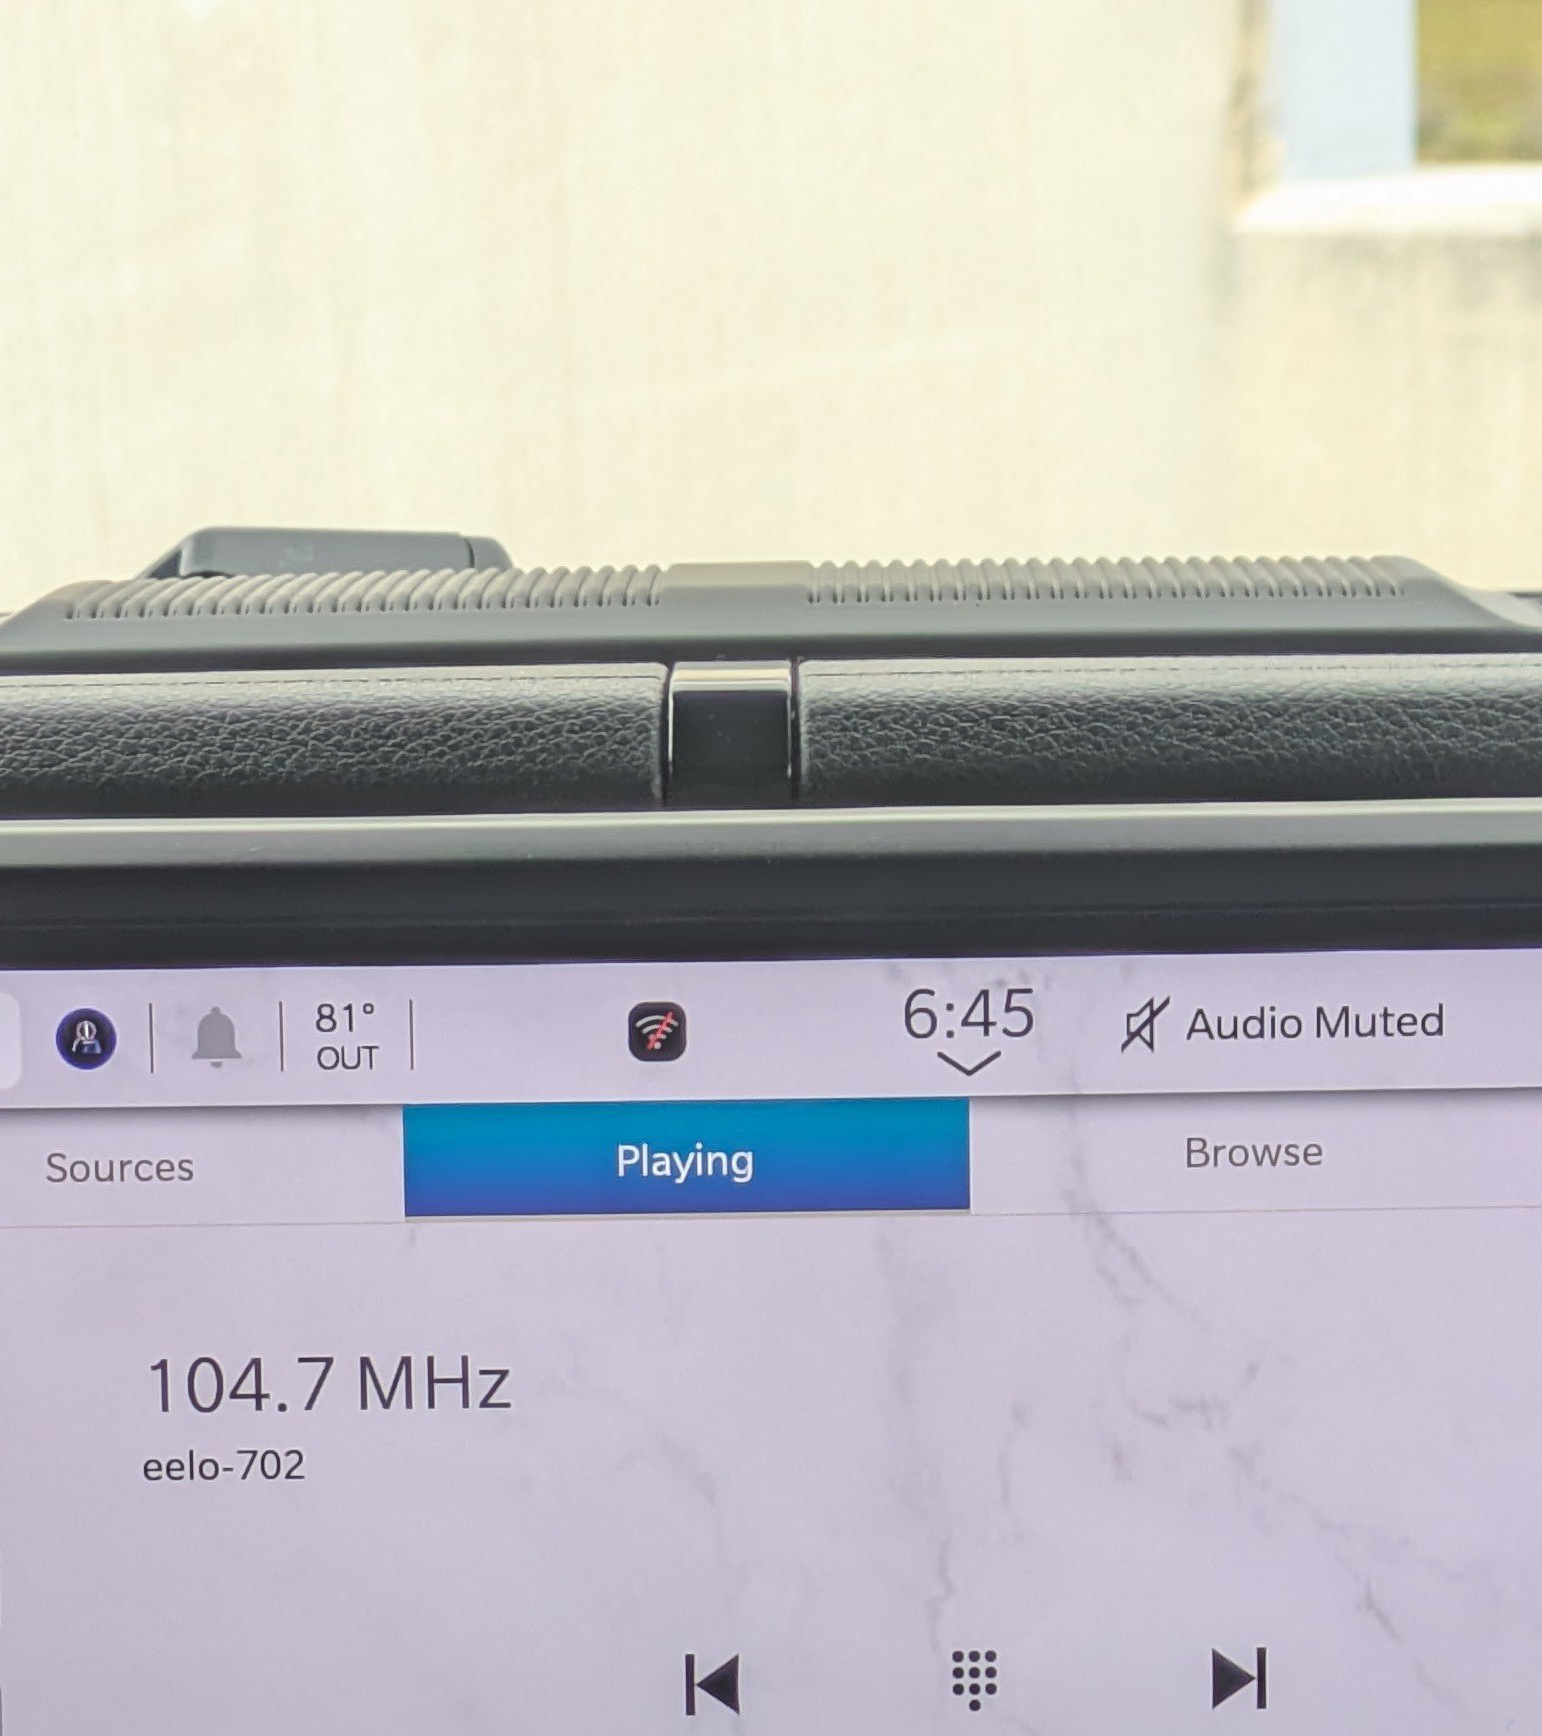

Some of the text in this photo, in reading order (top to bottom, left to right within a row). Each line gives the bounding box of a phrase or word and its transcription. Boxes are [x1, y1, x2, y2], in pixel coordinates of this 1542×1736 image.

[316, 1003, 375, 1033] 81°
[905, 988, 1033, 1038] 6:45
[1187, 1003, 1444, 1040] Audio Muted
[317, 1046, 379, 1071] OUT
[47, 1152, 193, 1183] Sources
[618, 1142, 754, 1183] Playing
[1186, 1137, 1323, 1168] Browse
[150, 1355, 512, 1413] 104.7 MHz
[143, 1450, 305, 1481] eelo-702
